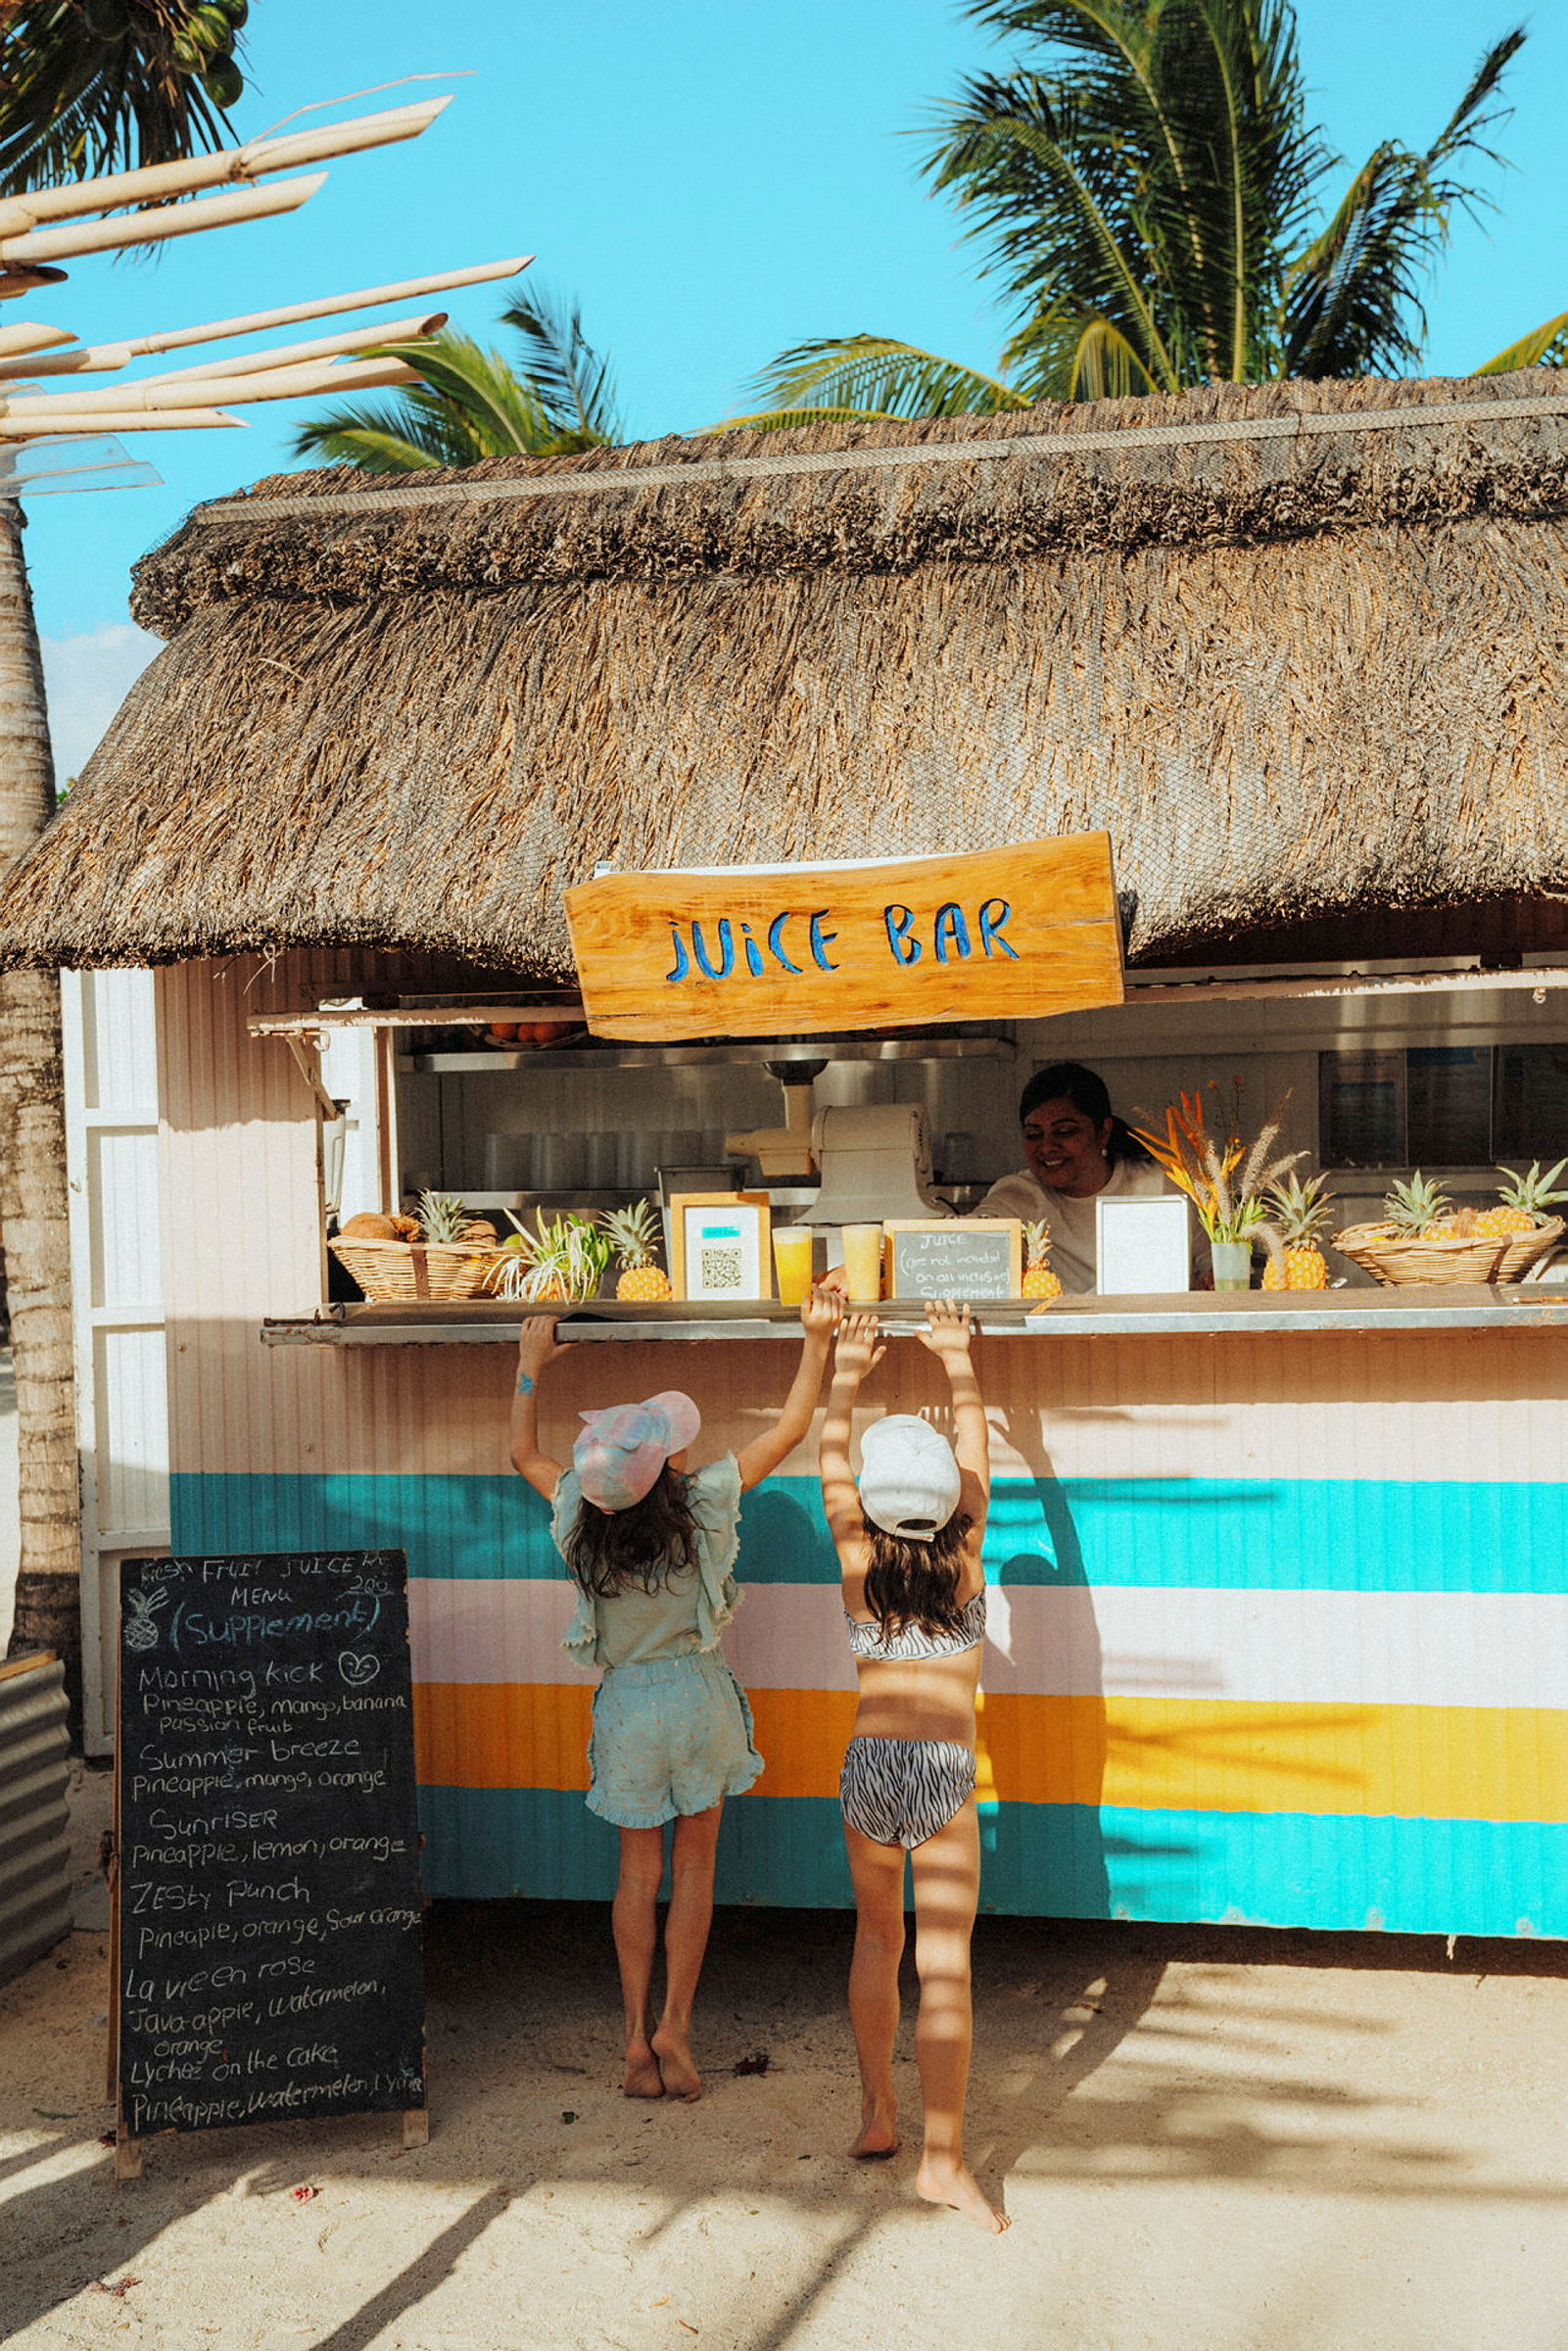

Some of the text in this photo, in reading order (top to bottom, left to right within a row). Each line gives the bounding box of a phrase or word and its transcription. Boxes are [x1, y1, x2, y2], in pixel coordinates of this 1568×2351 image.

[883, 897, 1021, 966] BAR
[920, 1234, 966, 1249] JUICE
[126, 1969, 154, 2002] La
[247, 2051, 277, 2075] the
